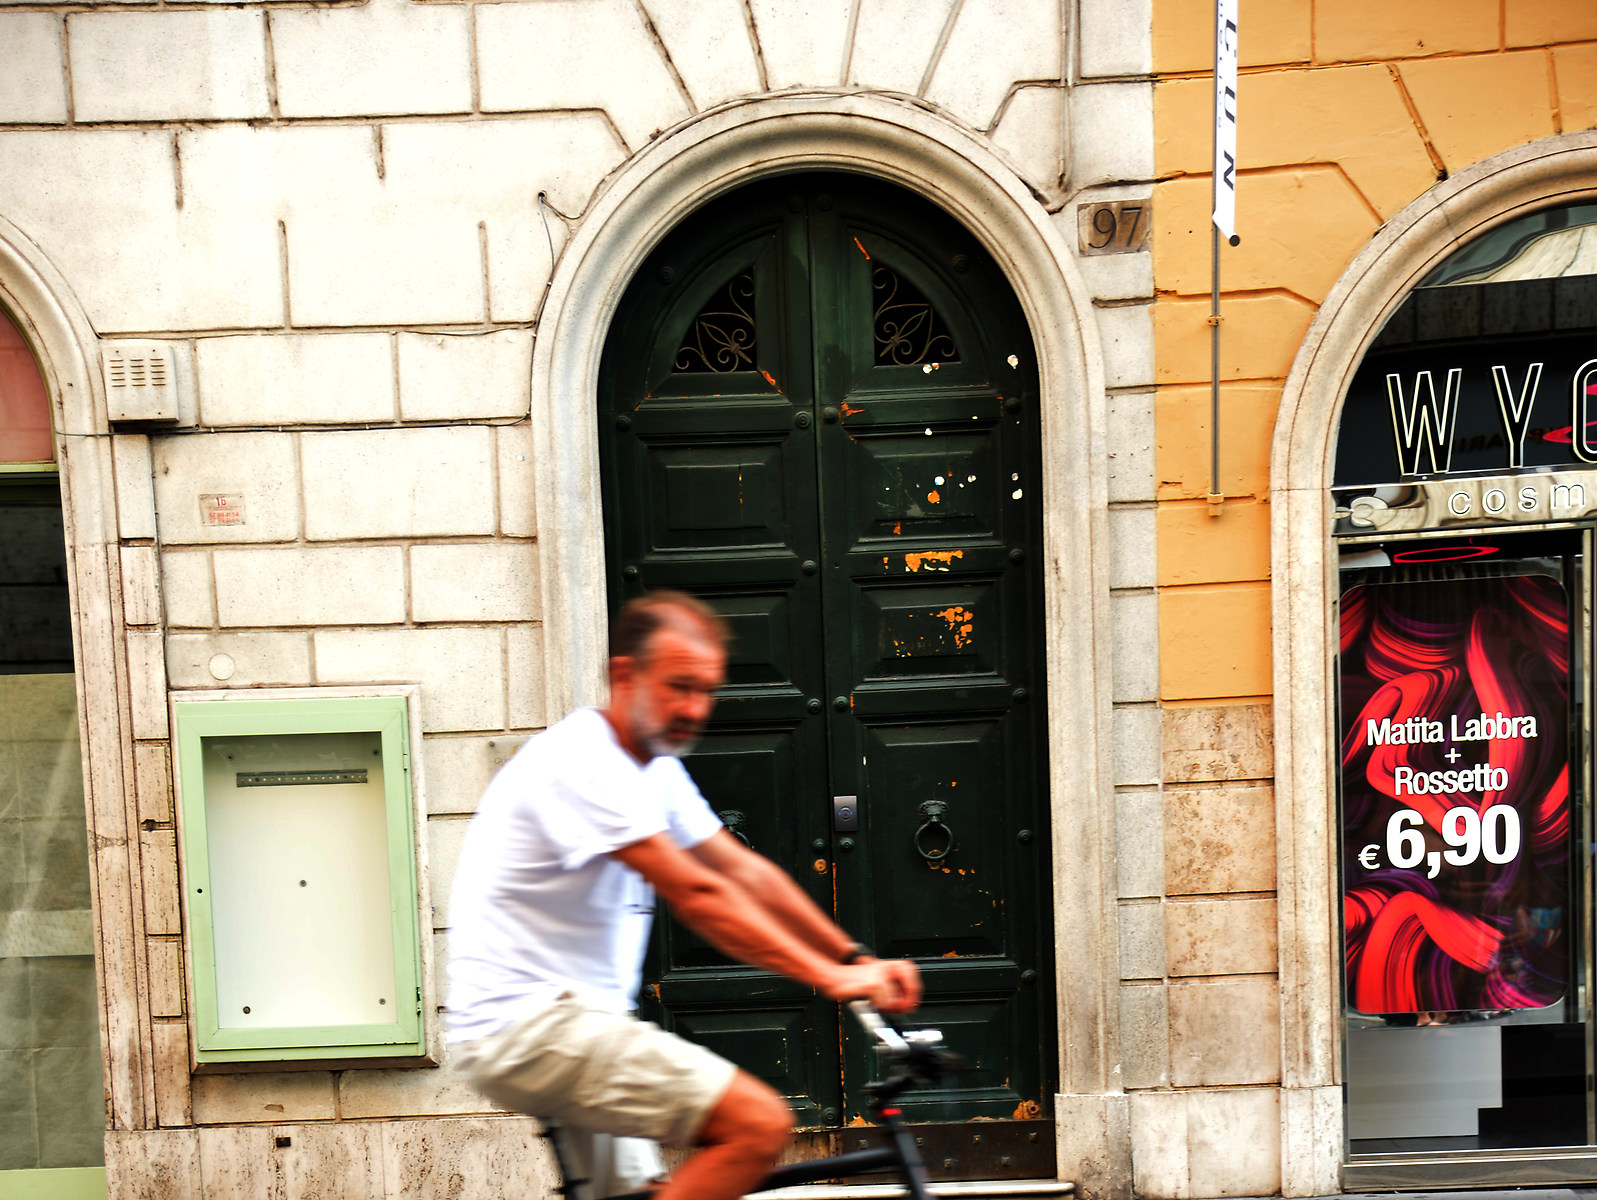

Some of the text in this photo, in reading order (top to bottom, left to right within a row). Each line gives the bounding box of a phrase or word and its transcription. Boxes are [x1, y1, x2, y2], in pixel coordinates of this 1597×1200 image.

[1087, 206, 1143, 249] 97
[215, 496, 226, 506] 16
[1448, 483, 1586, 515] cosm
[1366, 711, 1538, 747] Matita Labbra
[1394, 762, 1509, 796] Rossetto
[1386, 804, 1521, 880] 6,90
